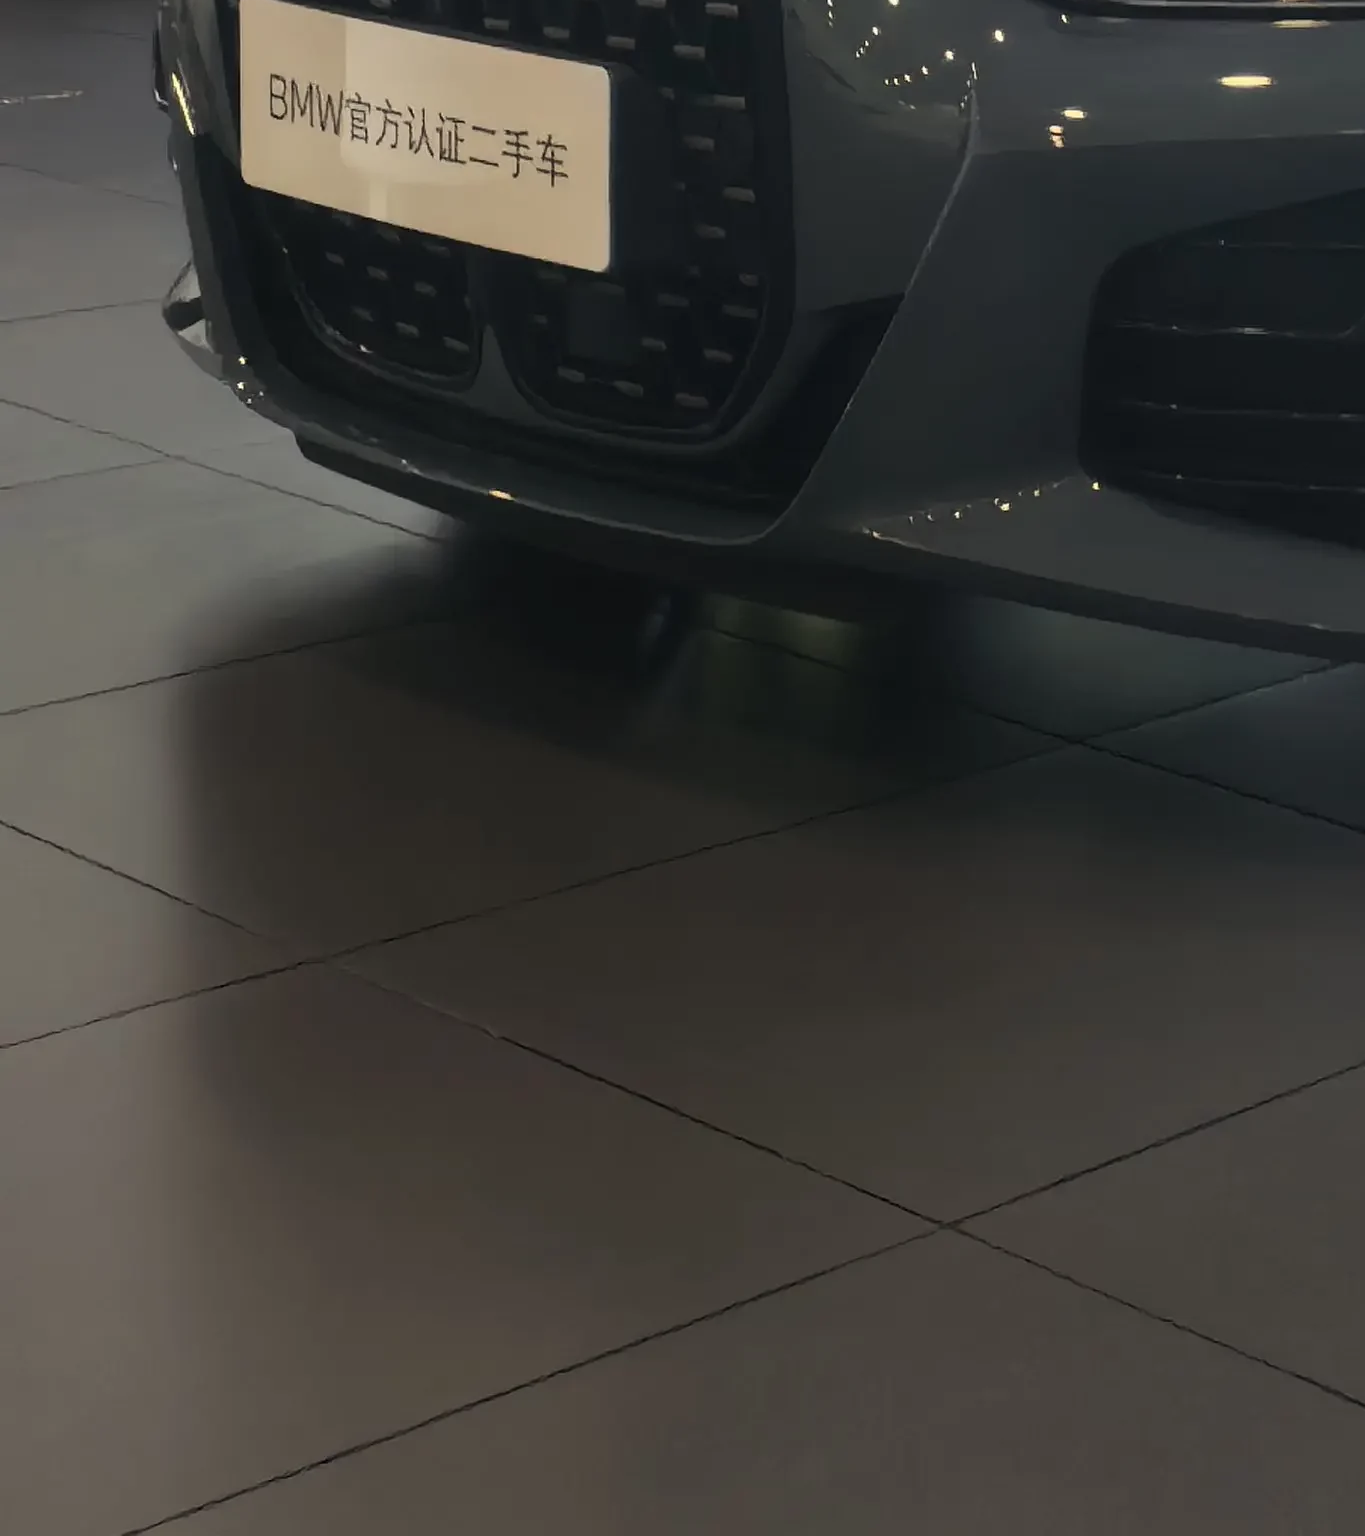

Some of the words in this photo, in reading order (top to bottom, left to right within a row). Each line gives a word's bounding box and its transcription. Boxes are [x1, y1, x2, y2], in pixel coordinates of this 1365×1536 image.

[269, 74, 569, 188] BMW官方认证二手车
